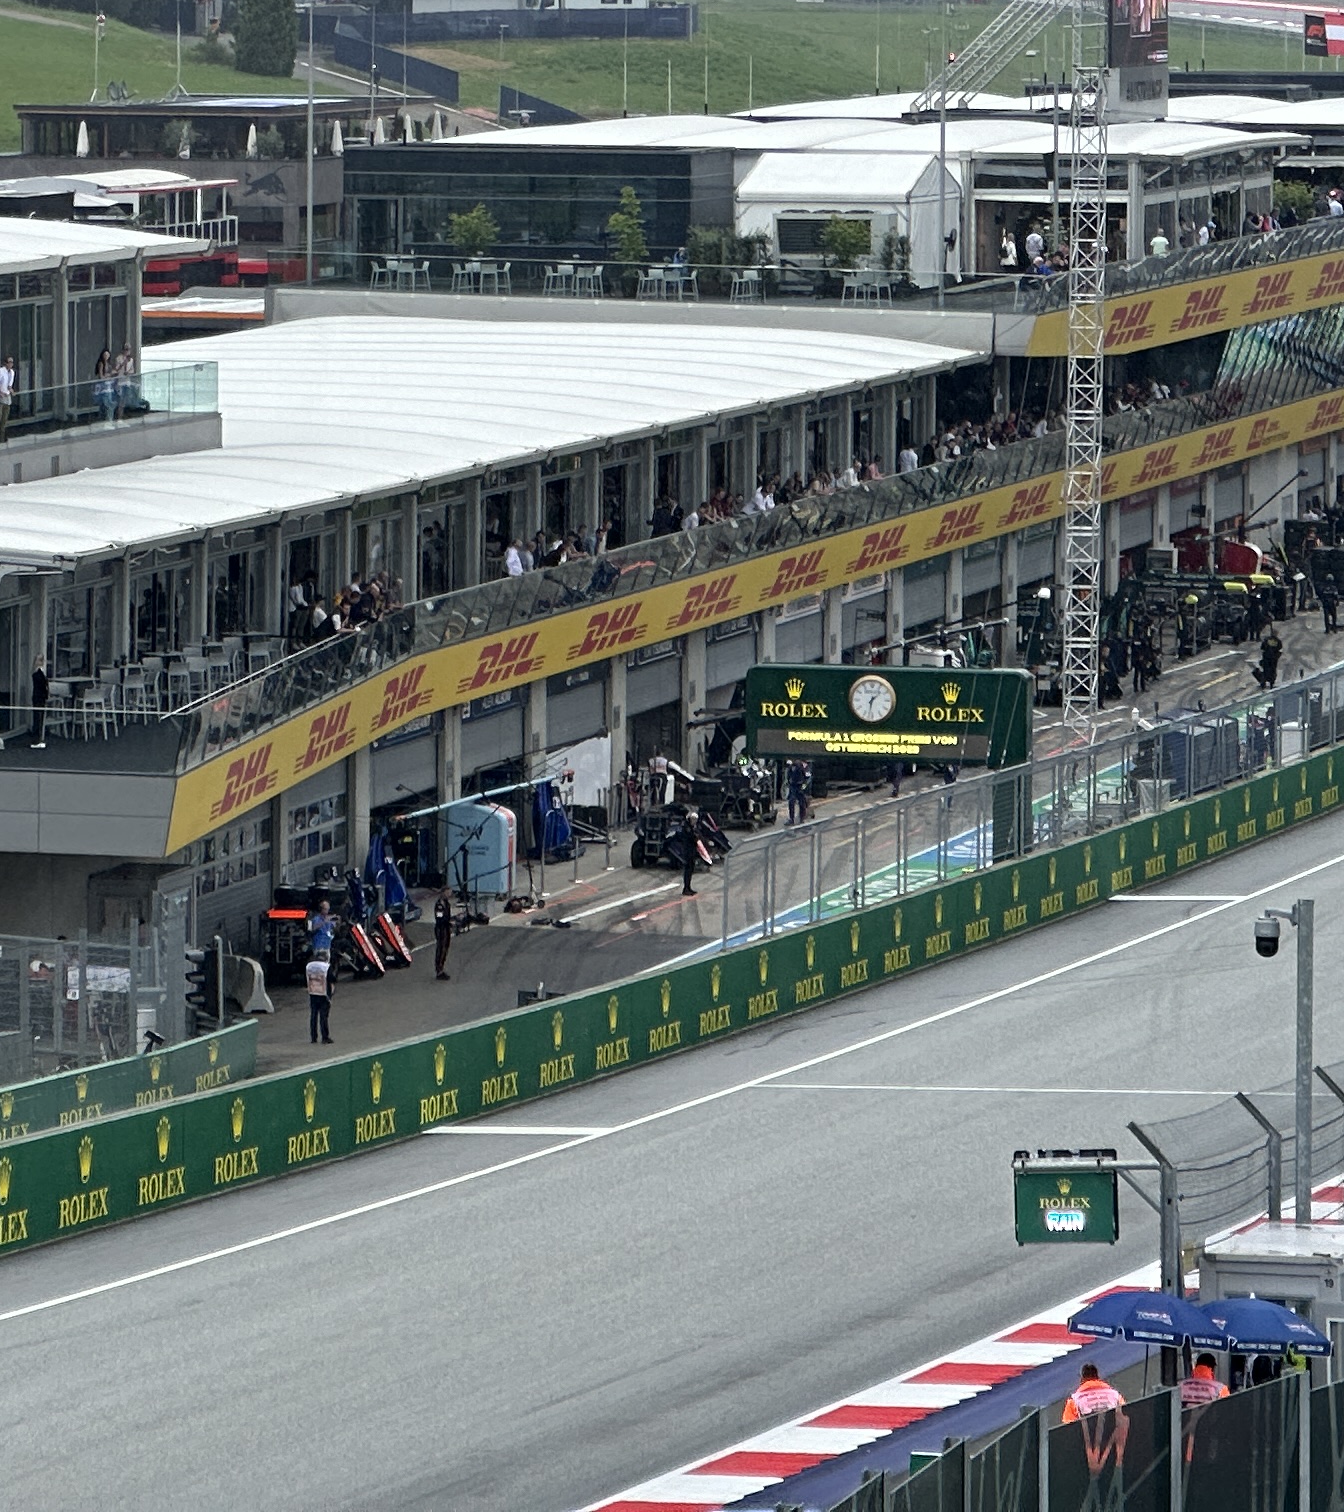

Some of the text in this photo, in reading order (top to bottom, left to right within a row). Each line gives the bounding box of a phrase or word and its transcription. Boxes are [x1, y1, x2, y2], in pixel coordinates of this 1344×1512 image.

[1174, 286, 1229, 332] DHL
[1243, 271, 1296, 315] DHL
[1102, 301, 1156, 348] DHL
[1134, 445, 1181, 485] DHL
[1194, 428, 1238, 468] DHL
[1003, 482, 1054, 525] DHL
[930, 503, 985, 549] DHL
[850, 524, 910, 573] DHL
[765, 549, 828, 598] DHL
[674, 575, 740, 626] DHL
[575, 602, 645, 656] DHL
[467, 632, 542, 689] DHL
[375, 664, 429, 728] DHL
[761, 704, 828, 718] ROLEX
[917, 707, 984, 723] ROLEX
[301, 701, 354, 769] DHL
[788, 732, 841, 742] FORMULA
[843, 733, 850, 742] 1
[933, 735, 957, 746] VON
[216, 742, 276, 817] DHL
[884, 945, 911, 973] ROLEX
[925, 931, 951, 959] ROLEX
[796, 973, 824, 1004] ROLEX
[841, 959, 868, 988] ROLEX
[700, 1004, 731, 1036] ROLEX
[748, 989, 778, 1020] ROLEX
[596, 1037, 630, 1070] ROLEX
[649, 1021, 681, 1053] ROLEX
[195, 1065, 230, 1092] ROLEX
[482, 1072, 518, 1105] ROLEX
[540, 1054, 574, 1087] ROLEX
[135, 1085, 173, 1107] ROLEX
[420, 1090, 458, 1125] ROLEX
[59, 1103, 102, 1128] ROLEX
[356, 1108, 396, 1144] ROLEX
[288, 1126, 330, 1164] ROLEX
[214, 1147, 259, 1184] ROLEX
[138, 1167, 185, 1205] ROLEX
[1039, 1197, 1091, 1209] ROLEX
[59, 1188, 108, 1228] ROLEX
[1047, 1213, 1084, 1232] RAIN
